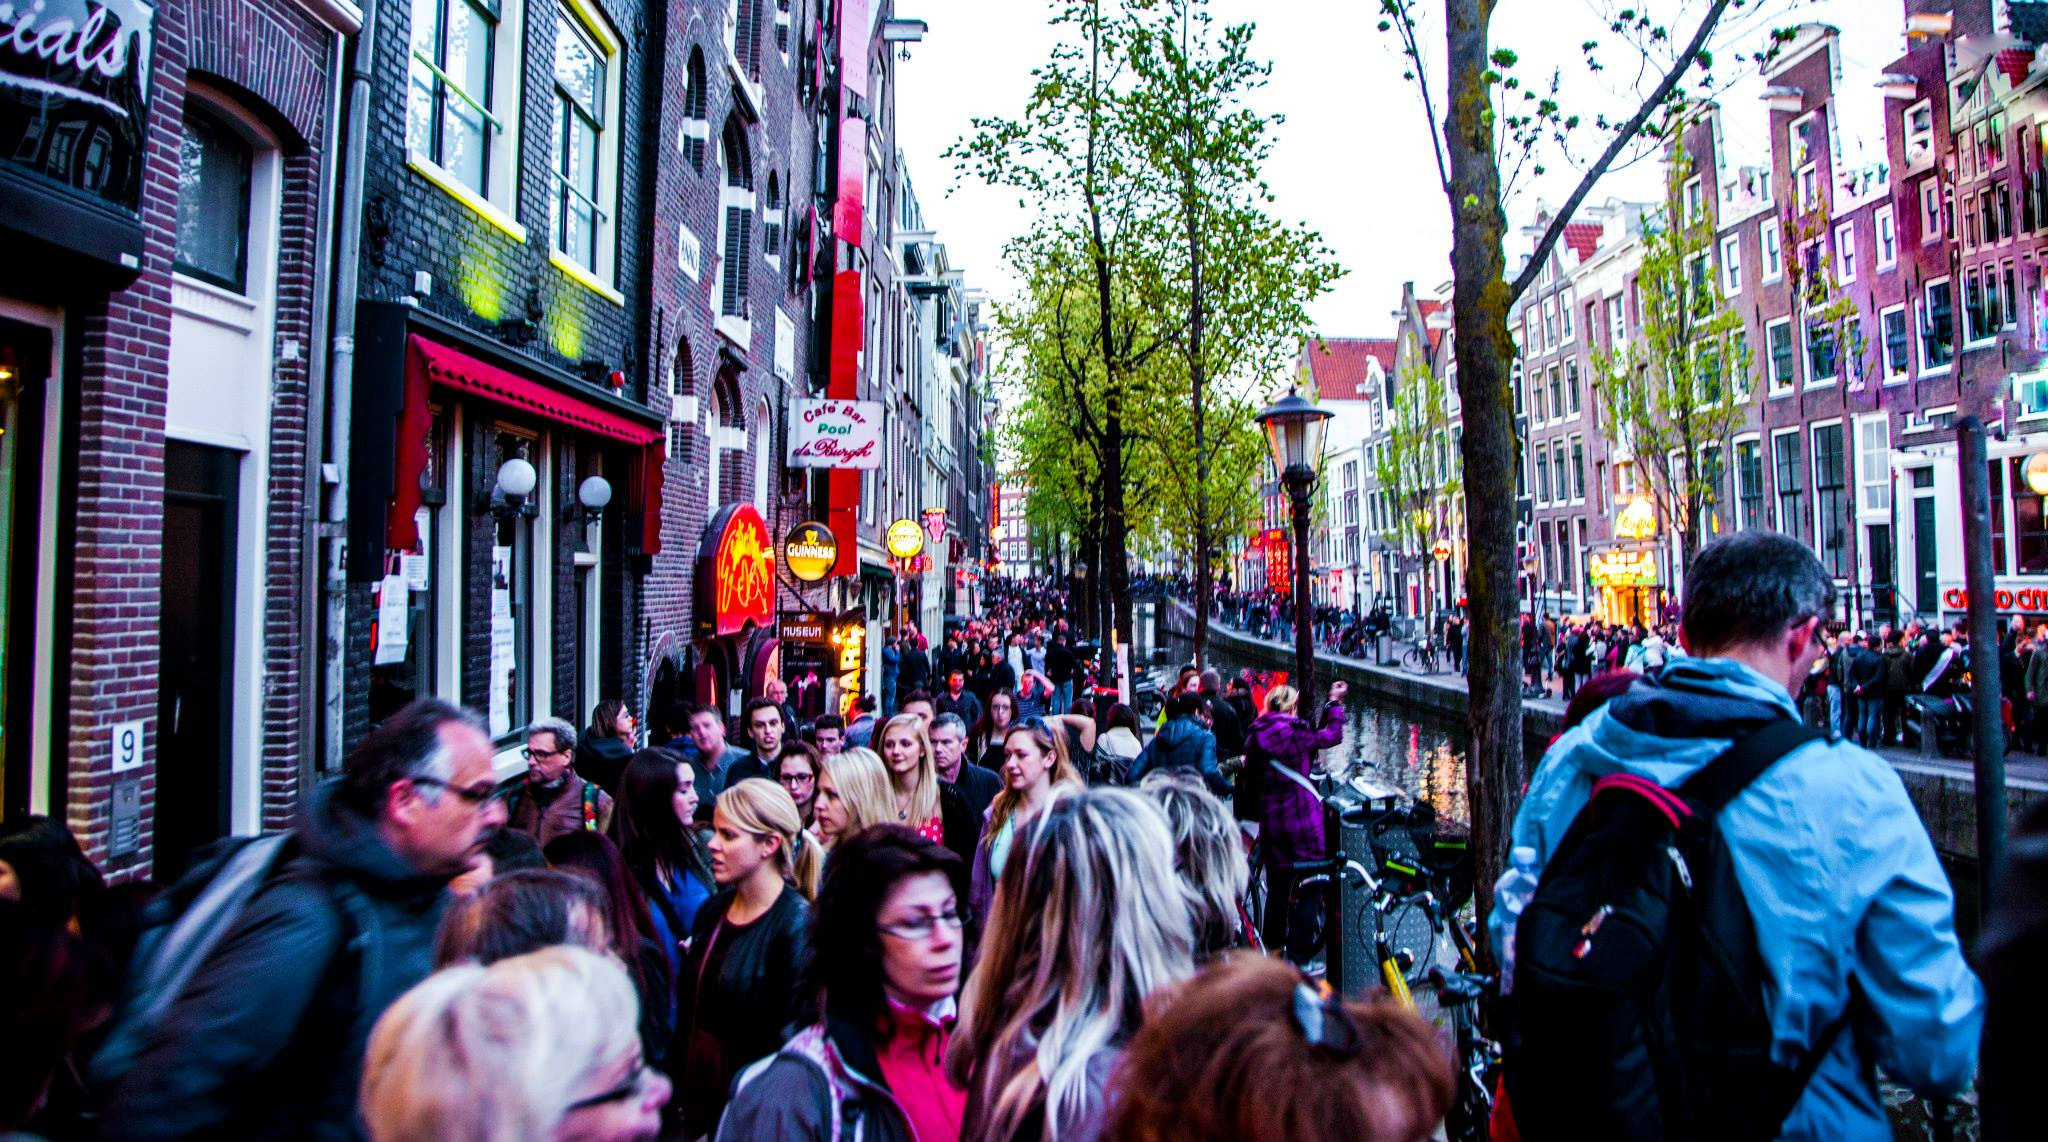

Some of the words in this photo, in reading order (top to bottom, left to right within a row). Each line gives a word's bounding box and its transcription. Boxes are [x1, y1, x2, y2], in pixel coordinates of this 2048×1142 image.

[842, 405, 866, 424] Bar
[818, 423, 852, 434] Pool
[786, 543, 834, 559] GUINNESS
[783, 626, 821, 637] MUSEUM
[121, 729, 135, 763] 9
